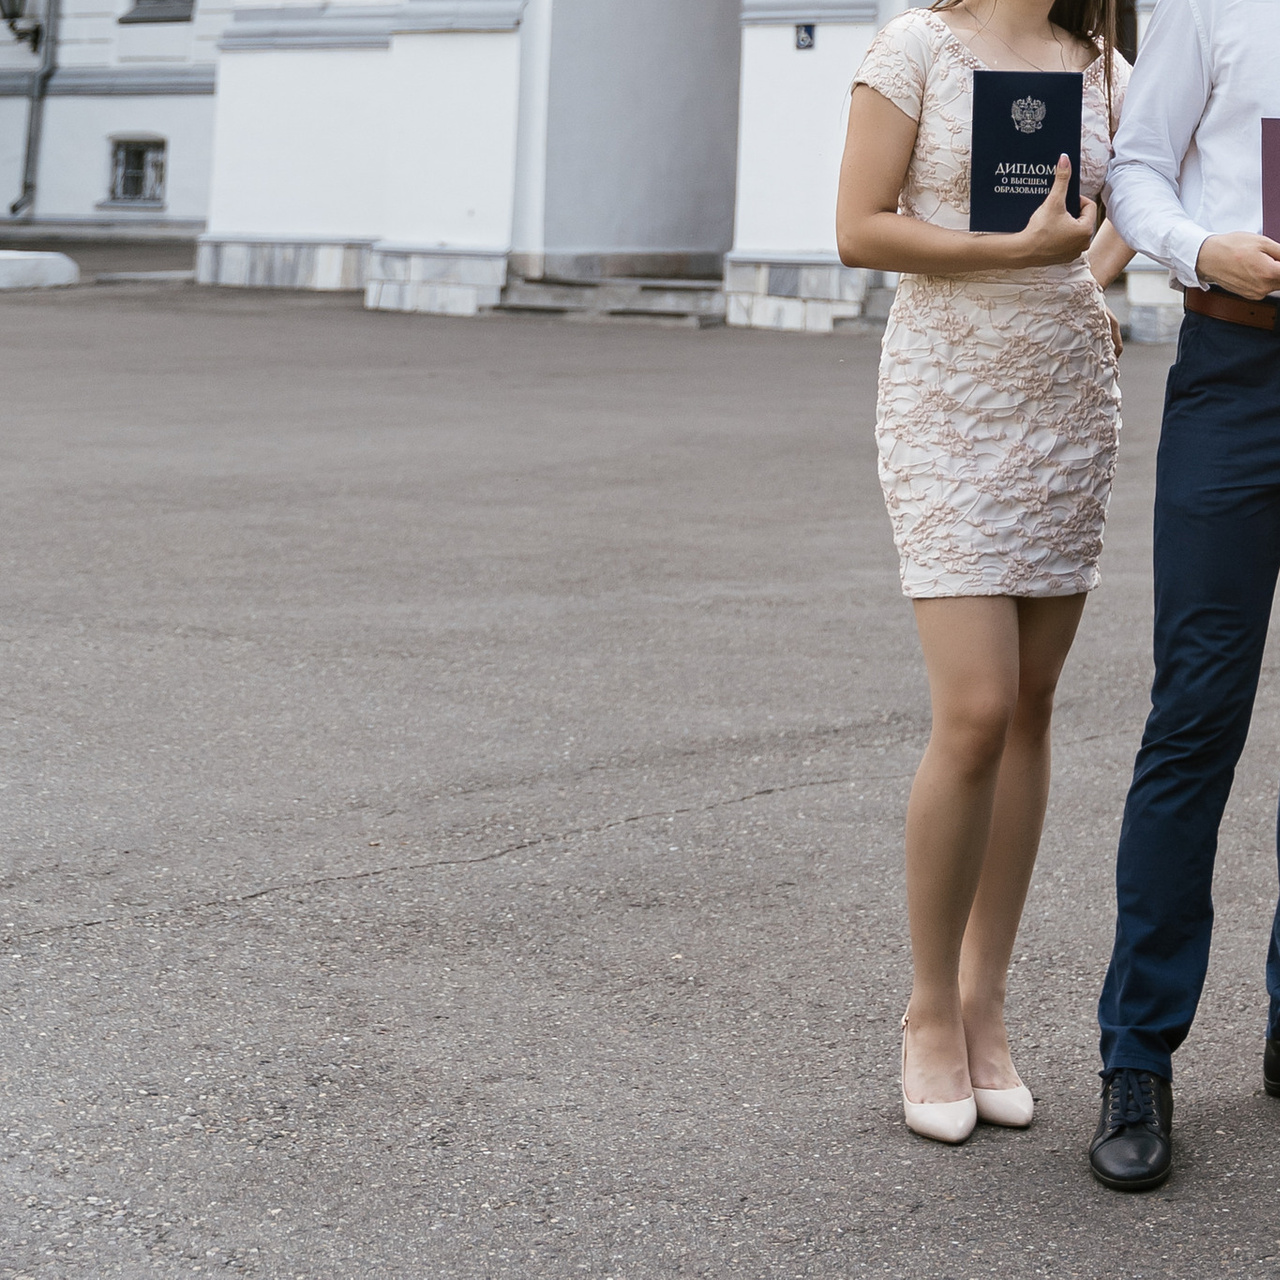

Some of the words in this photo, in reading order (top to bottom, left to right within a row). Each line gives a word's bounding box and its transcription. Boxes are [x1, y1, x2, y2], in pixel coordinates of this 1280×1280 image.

[994, 162, 1057, 176] ДИПЛОМ
[1001, 177, 1008, 185] О
[1010, 177, 1048, 185] ВЫСШЕМ
